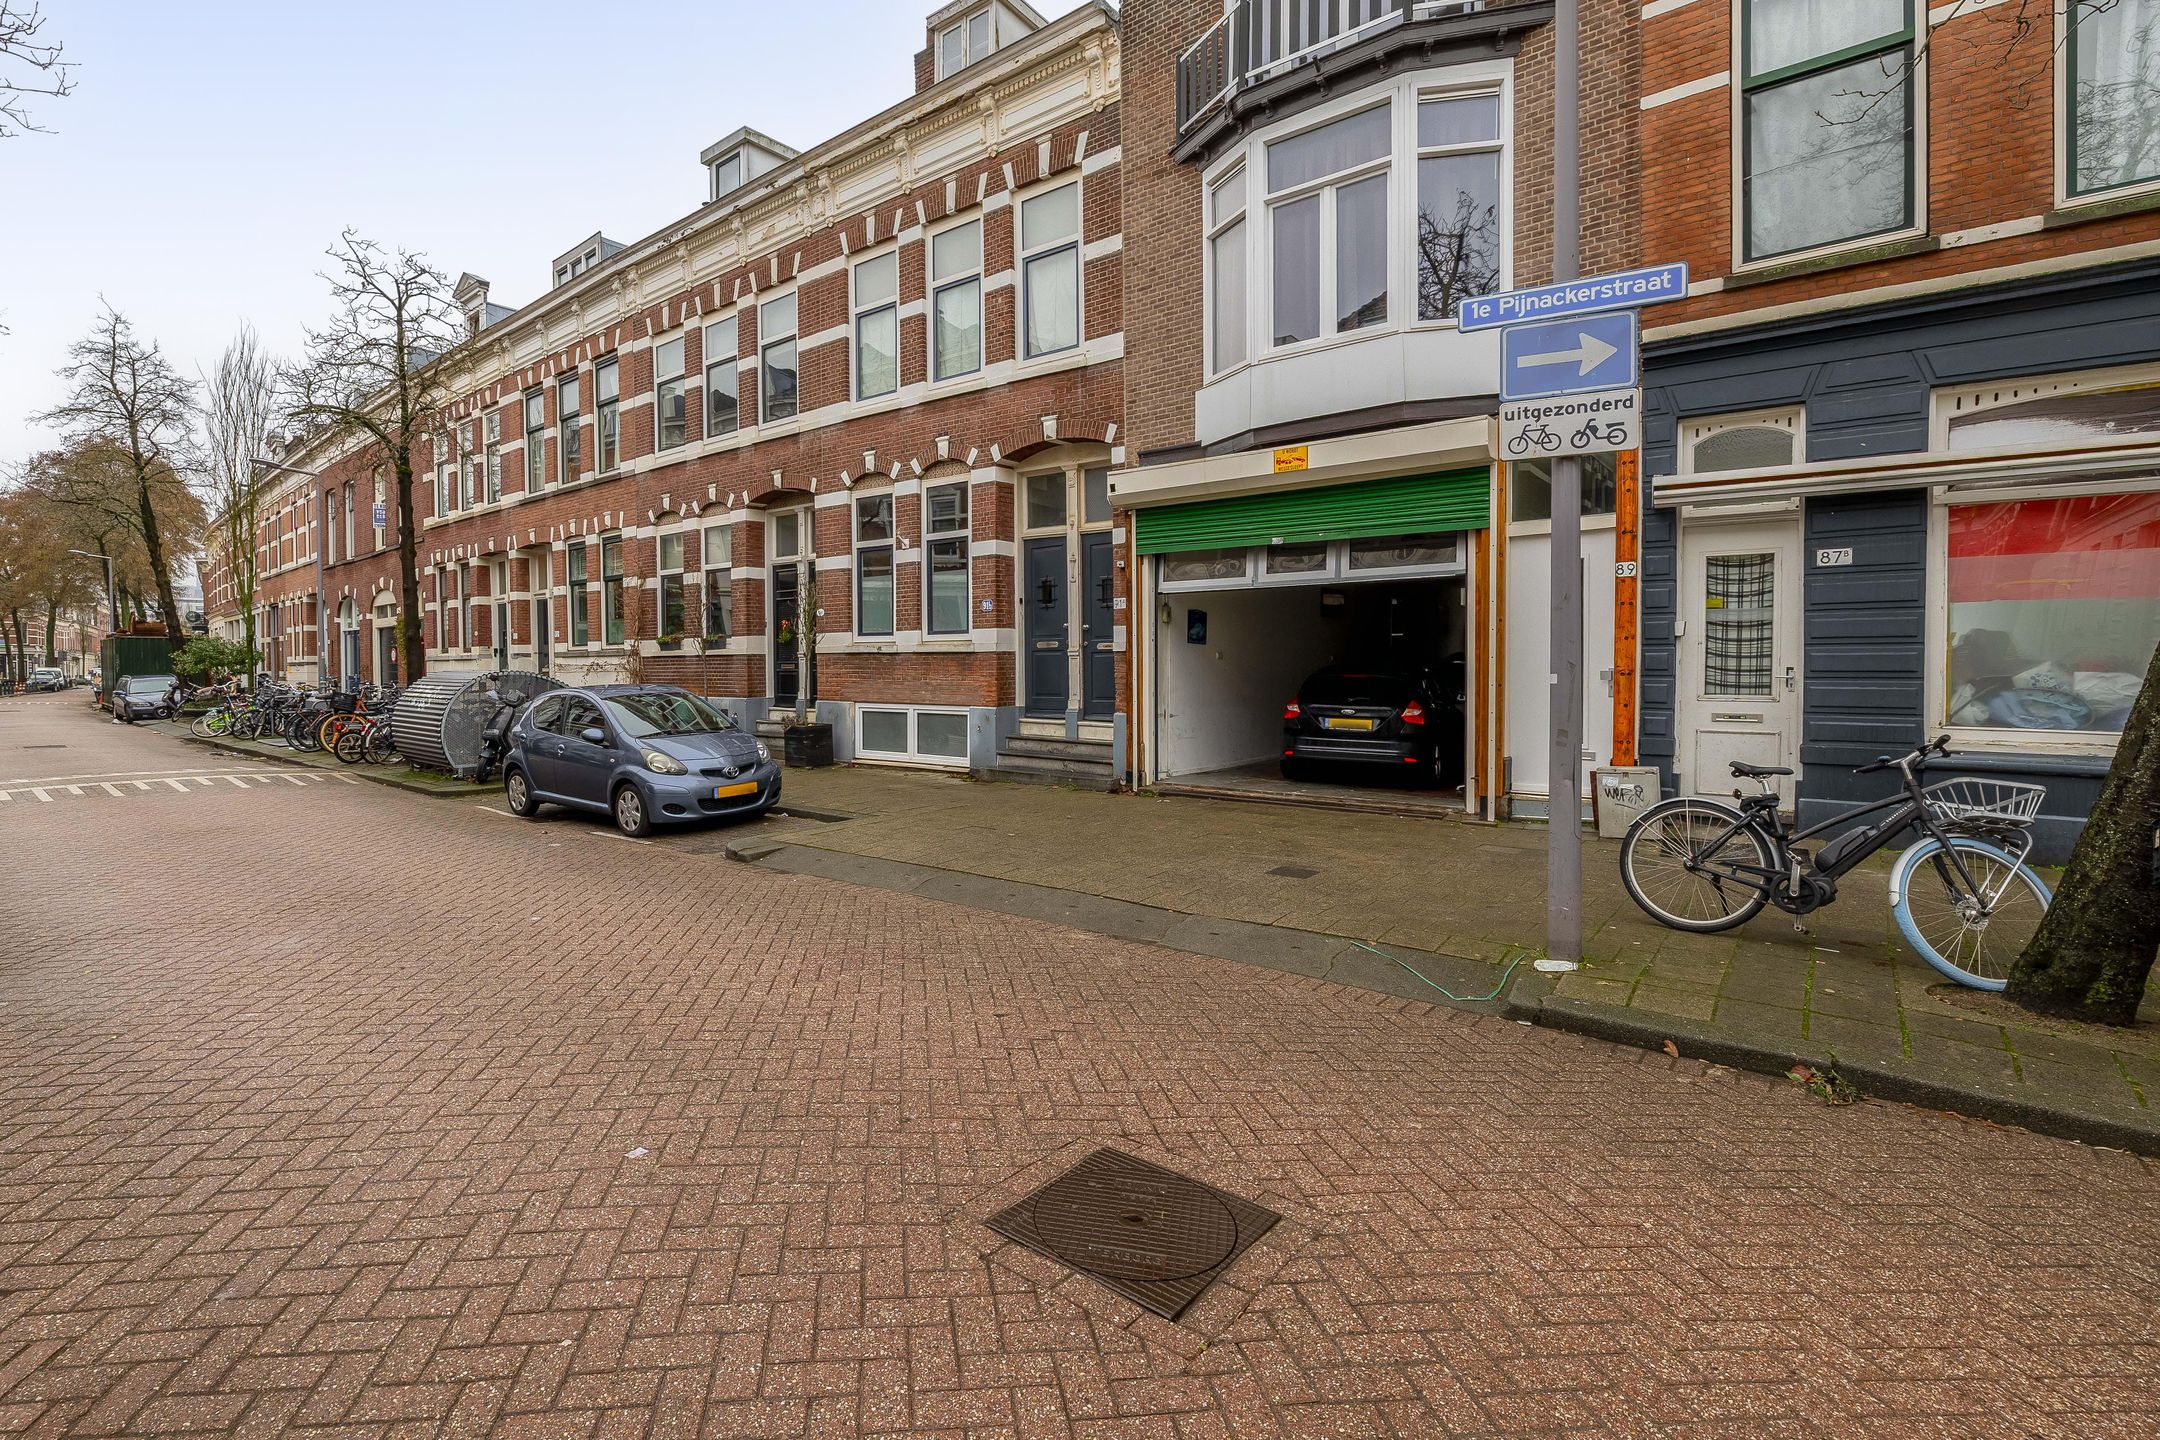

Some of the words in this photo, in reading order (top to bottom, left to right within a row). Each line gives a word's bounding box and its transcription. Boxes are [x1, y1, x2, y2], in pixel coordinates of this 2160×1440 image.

[1471, 302, 1491, 319] 1e
[1500, 271, 1672, 317] Pijnackerstraat
[1504, 394, 1634, 423] uitgezonderd
[1821, 550, 1849, 564] 87B
[1616, 563, 1635, 575] 89
